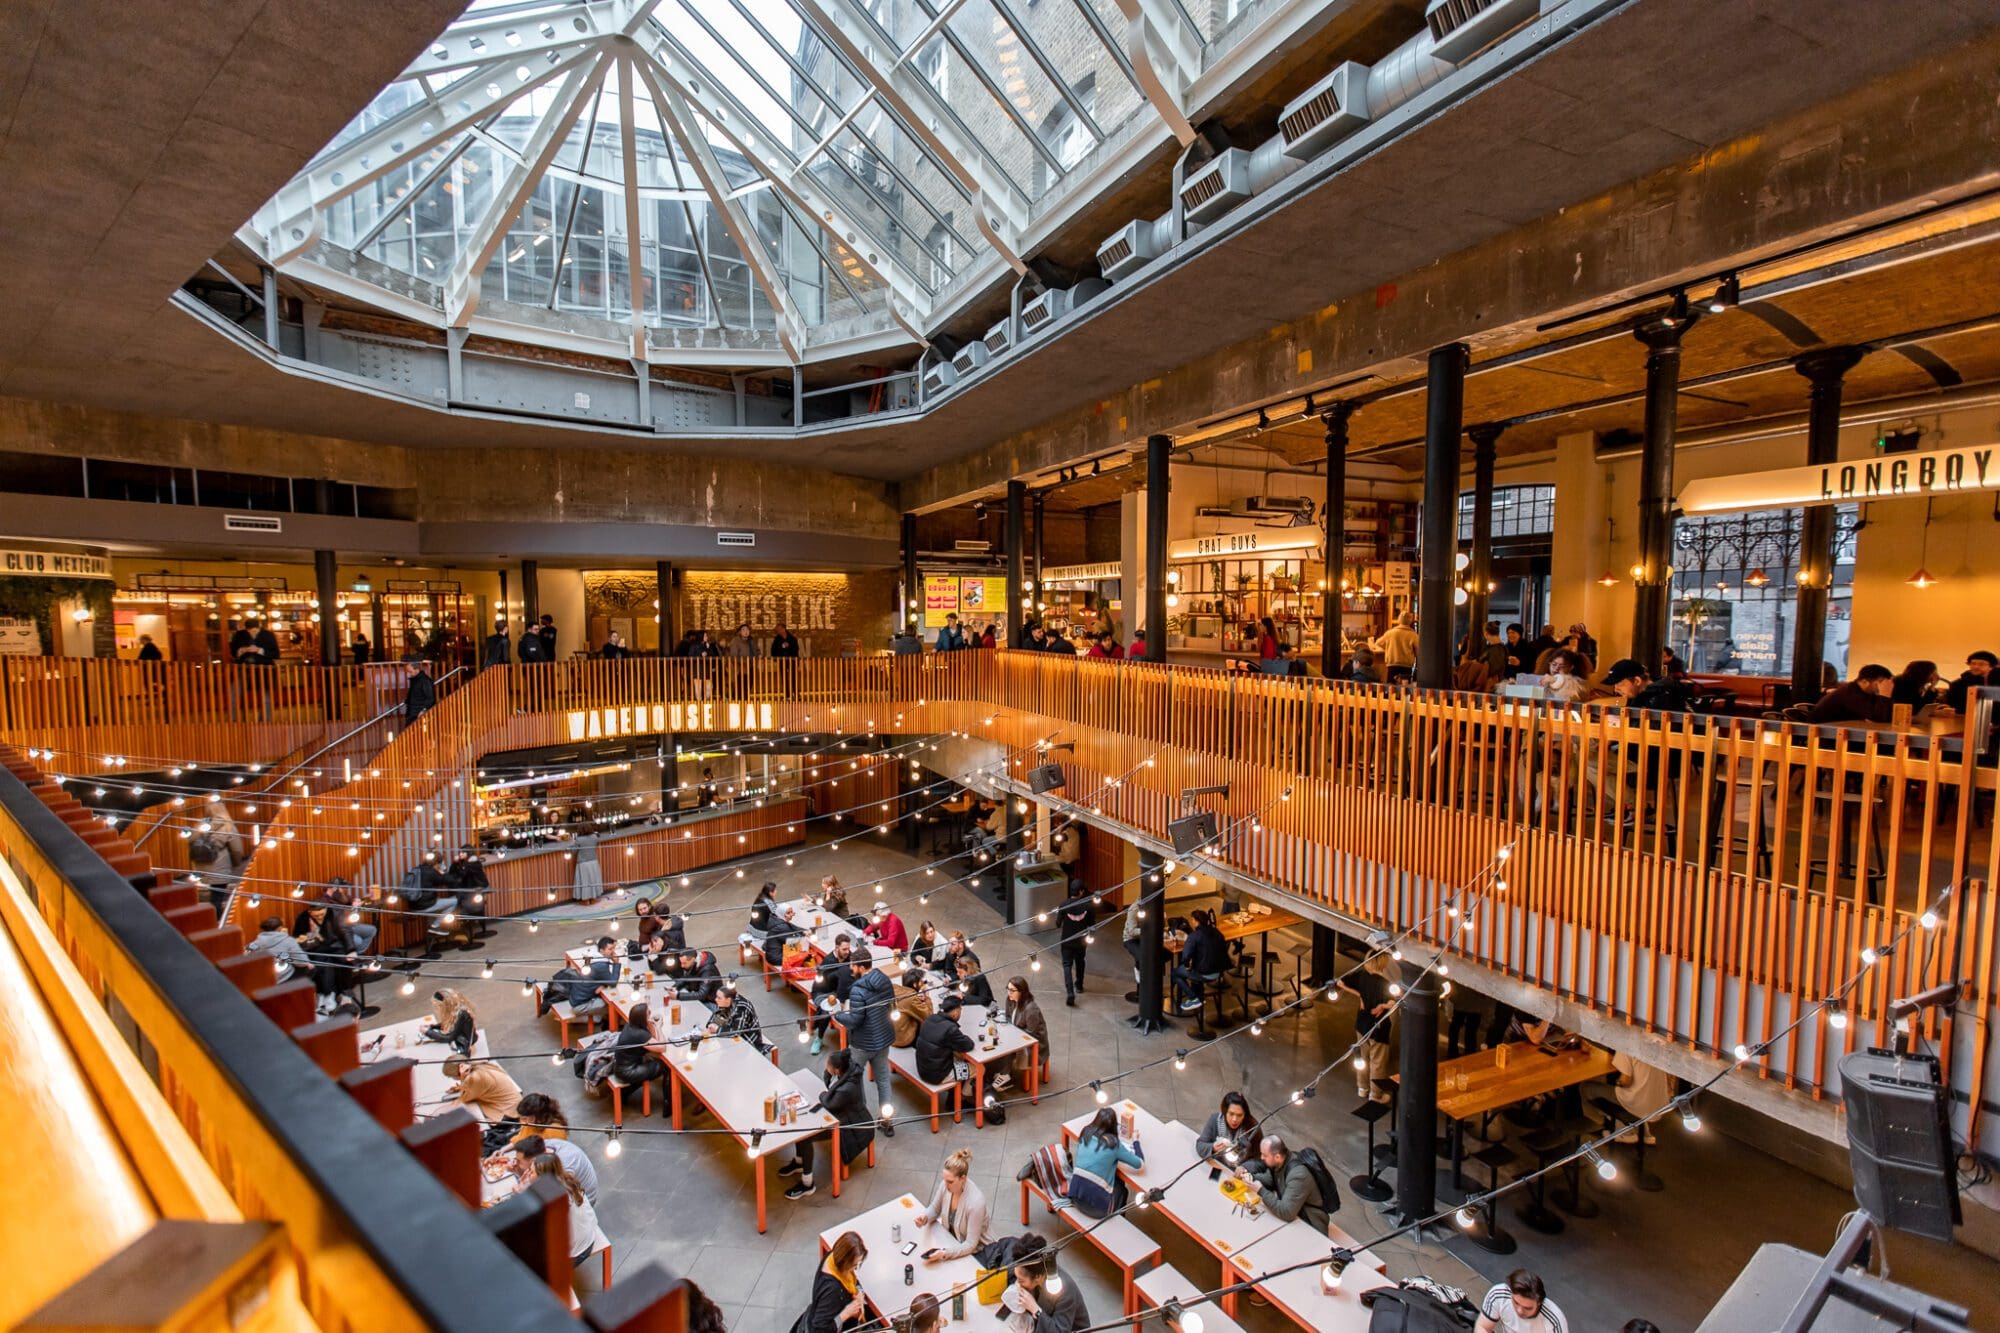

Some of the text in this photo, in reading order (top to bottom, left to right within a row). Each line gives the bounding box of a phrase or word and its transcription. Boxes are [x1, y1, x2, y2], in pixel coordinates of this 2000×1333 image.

[1822, 449, 1992, 498] LONGBOY
[1198, 534, 1257, 553] CHAI GUYS
[6, 553, 45, 571] CLUB
[691, 594, 836, 630] TASTES LIKE
[567, 703, 773, 740] WAREHOUSE BAR
